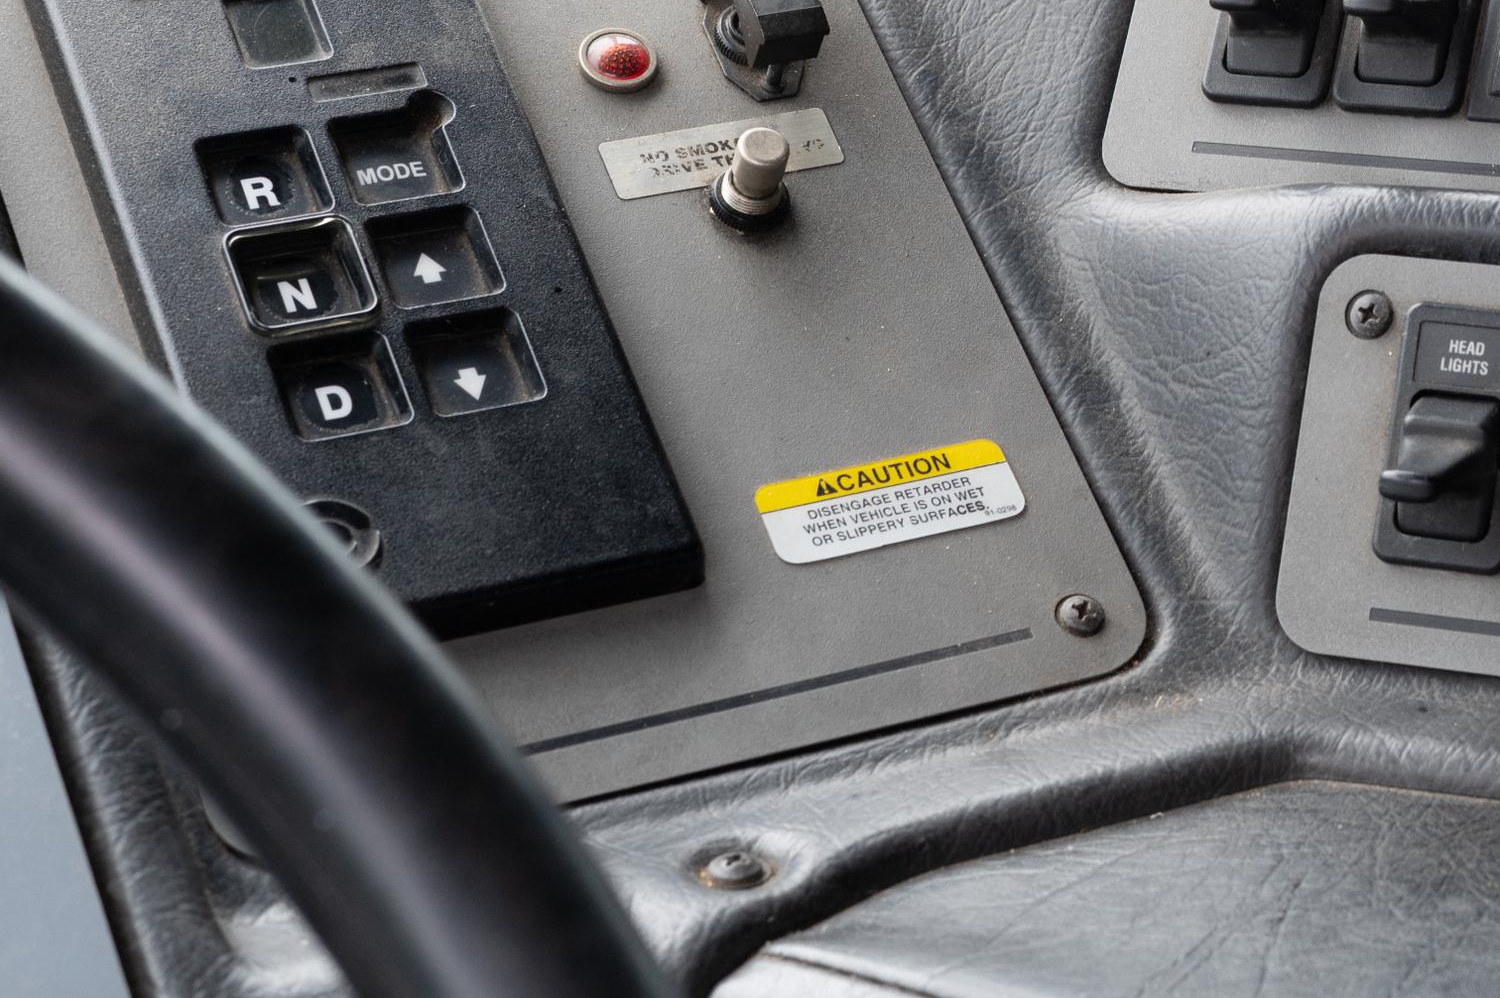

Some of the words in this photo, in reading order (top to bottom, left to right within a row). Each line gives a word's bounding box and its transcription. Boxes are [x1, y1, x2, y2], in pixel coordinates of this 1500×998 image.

[356, 161, 427, 186] MODE
[240, 176, 281, 211] R
[277, 277, 318, 314] N
[1449, 339, 1486, 356] HEAD
[1440, 357, 1489, 376] LIGHTS
[314, 384, 354, 421] D
[836, 453, 952, 492] CAUTION
[803, 517, 849, 535] WHEN
[850, 503, 909, 526] VEHICLE
[914, 500, 927, 511] IS
[930, 495, 954, 509] ON
[953, 486, 985, 503] WET
[807, 493, 892, 521] DISENGAGE
[896, 476, 972, 503] RETARDER
[812, 534, 835, 547] OR
[837, 518, 907, 542] SLIPPERY
[910, 501, 990, 526] SURFACES.
